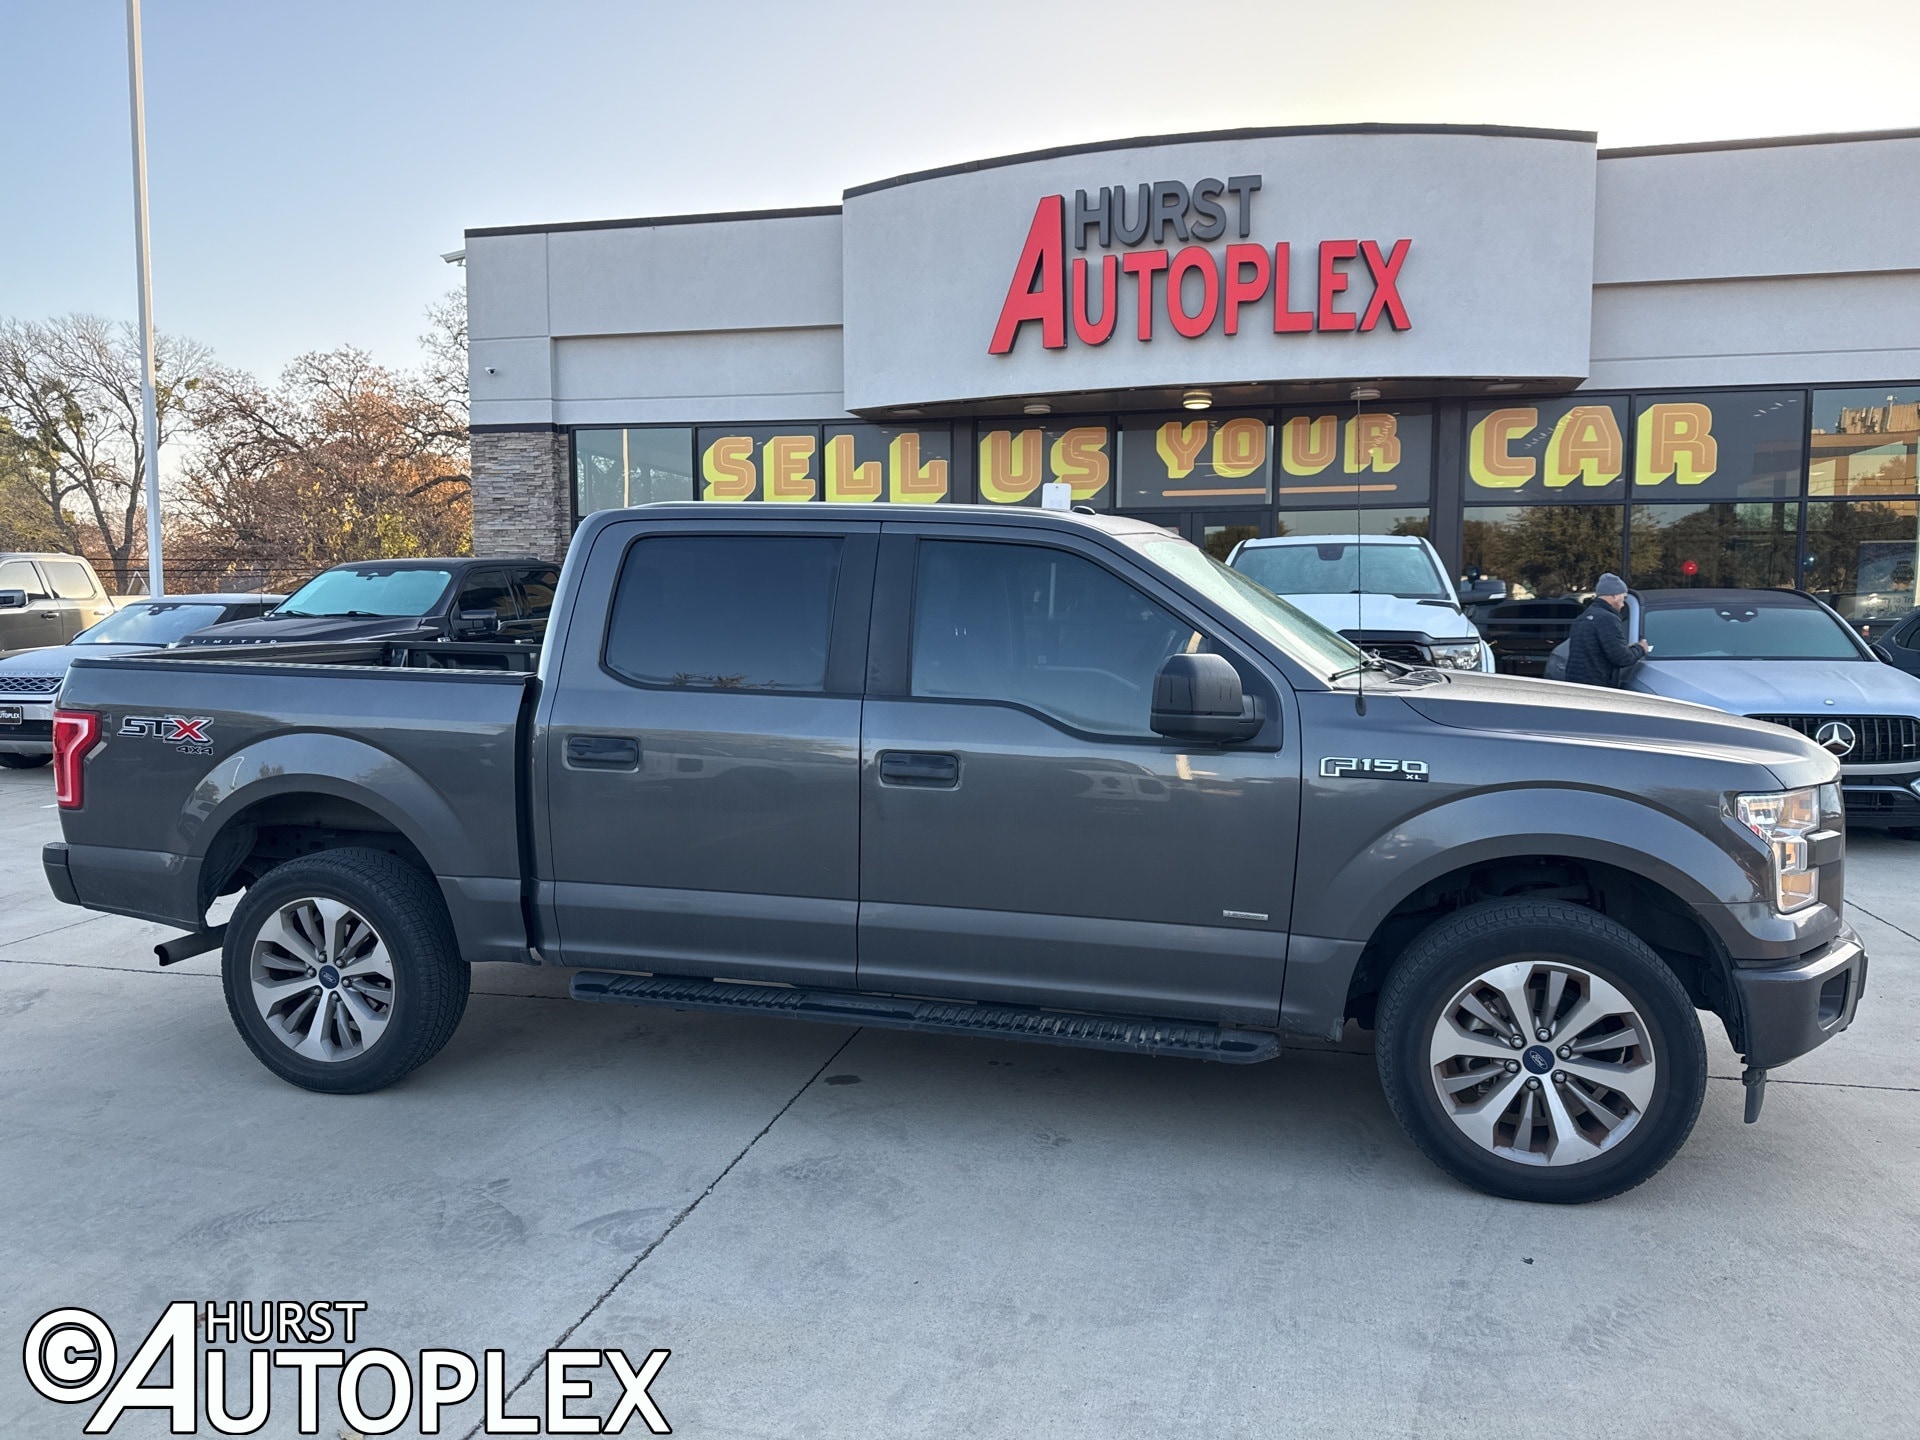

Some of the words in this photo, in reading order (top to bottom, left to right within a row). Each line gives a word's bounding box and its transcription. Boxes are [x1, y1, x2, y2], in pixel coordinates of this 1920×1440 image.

[1074, 174, 1262, 250] HURST
[988, 194, 1412, 355] AUTOPLEX
[703, 432, 948, 503] SELL
[980, 426, 1109, 503] US
[1156, 412, 1401, 479] YOUR
[1470, 402, 1717, 488] CAR
[117, 715, 214, 745] STX
[1530, 1052, 1547, 1068] Ford
